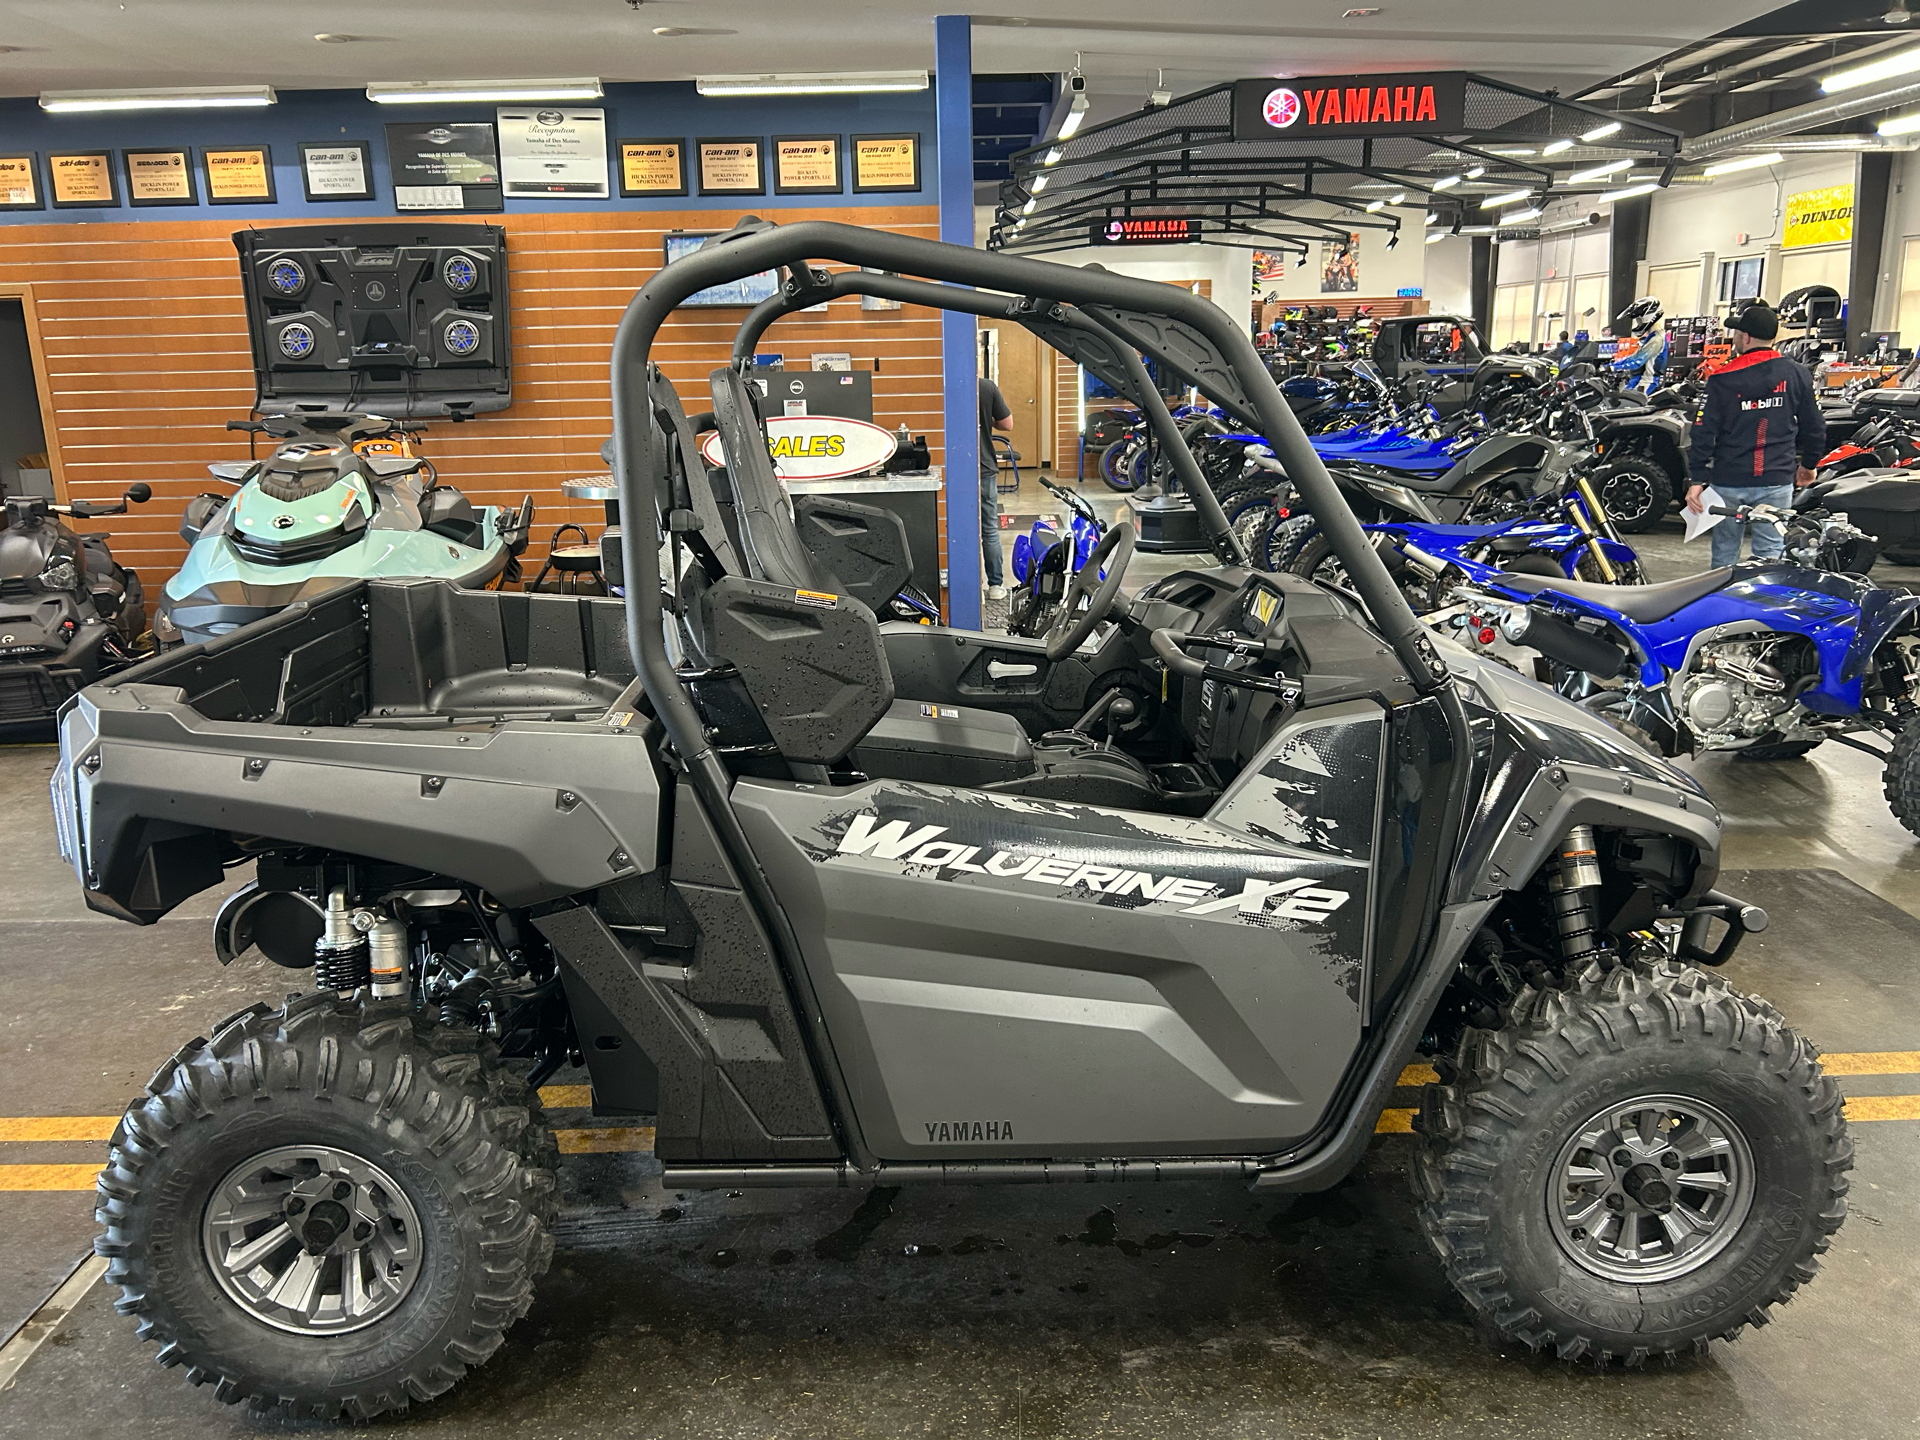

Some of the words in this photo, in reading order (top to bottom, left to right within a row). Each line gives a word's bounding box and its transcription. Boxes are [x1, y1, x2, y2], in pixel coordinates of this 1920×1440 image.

[1302, 85, 1437, 125] YAMAHA
[528, 124, 576, 136] Recognition
[1123, 220, 1188, 239] YAMAHA
[1499, 230, 1539, 238] PARTS
[1398, 288, 1421, 297] PARTS
[1742, 398, 1772, 411] Mobil
[766, 435, 845, 458] SALES
[1367, 483, 1384, 492] YAMAHA
[836, 813, 1218, 906] WOLVERINE
[1190, 877, 1350, 922] X2
[924, 1121, 1014, 1142] YAMAHA
